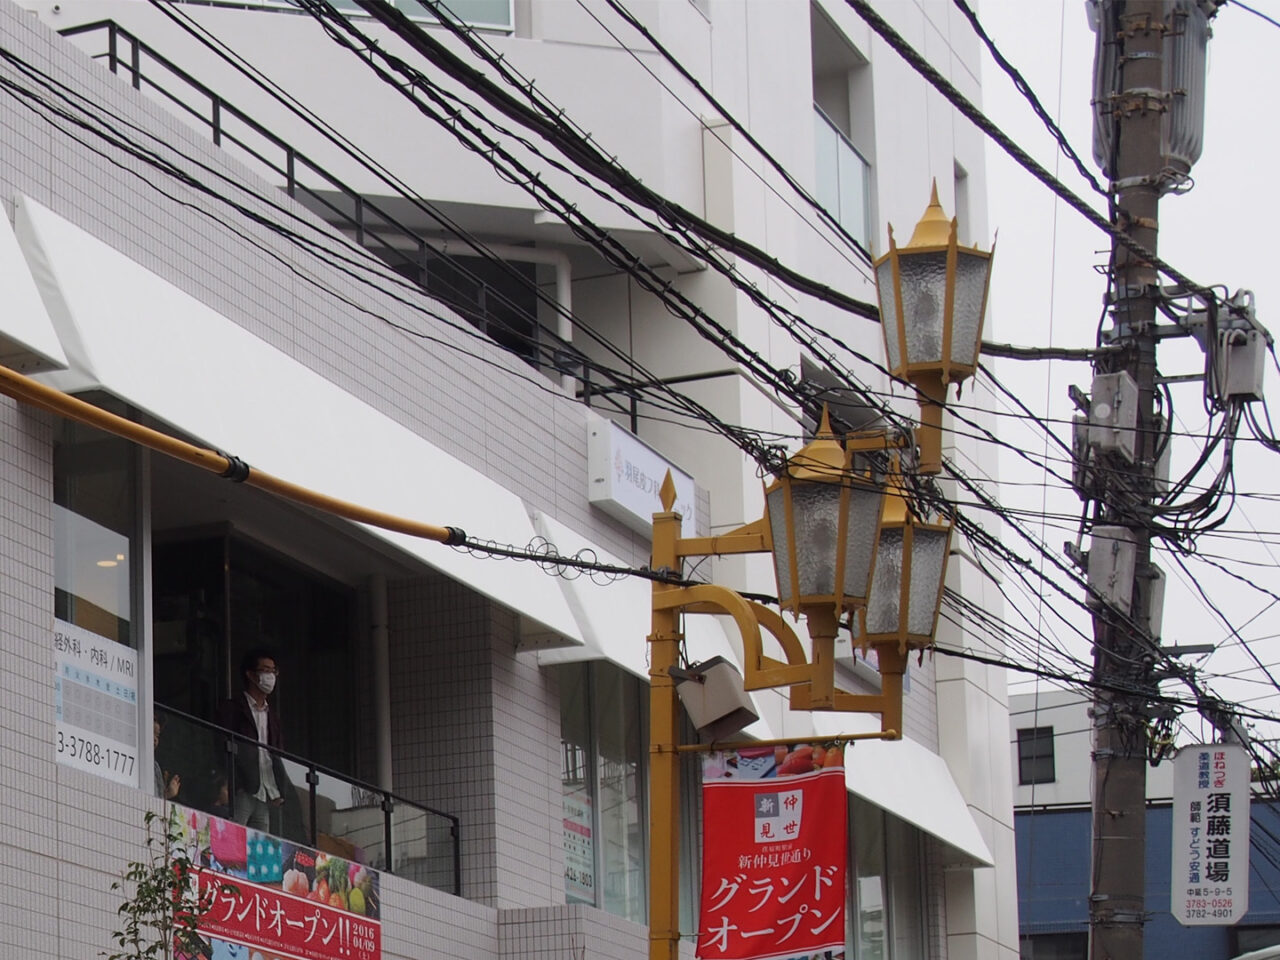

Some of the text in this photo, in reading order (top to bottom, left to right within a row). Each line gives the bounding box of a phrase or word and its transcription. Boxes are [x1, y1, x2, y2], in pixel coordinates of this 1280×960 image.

[117, 657, 134, 678] MRI
[1213, 751, 1226, 789] ほねつぎ
[1205, 792, 1231, 883] 須藤道場
[738, 847, 812, 869] 新仲見世通り
[707, 865, 838, 913] グランド
[352, 923, 375, 940] 2016
[701, 904, 841, 953] オープン
